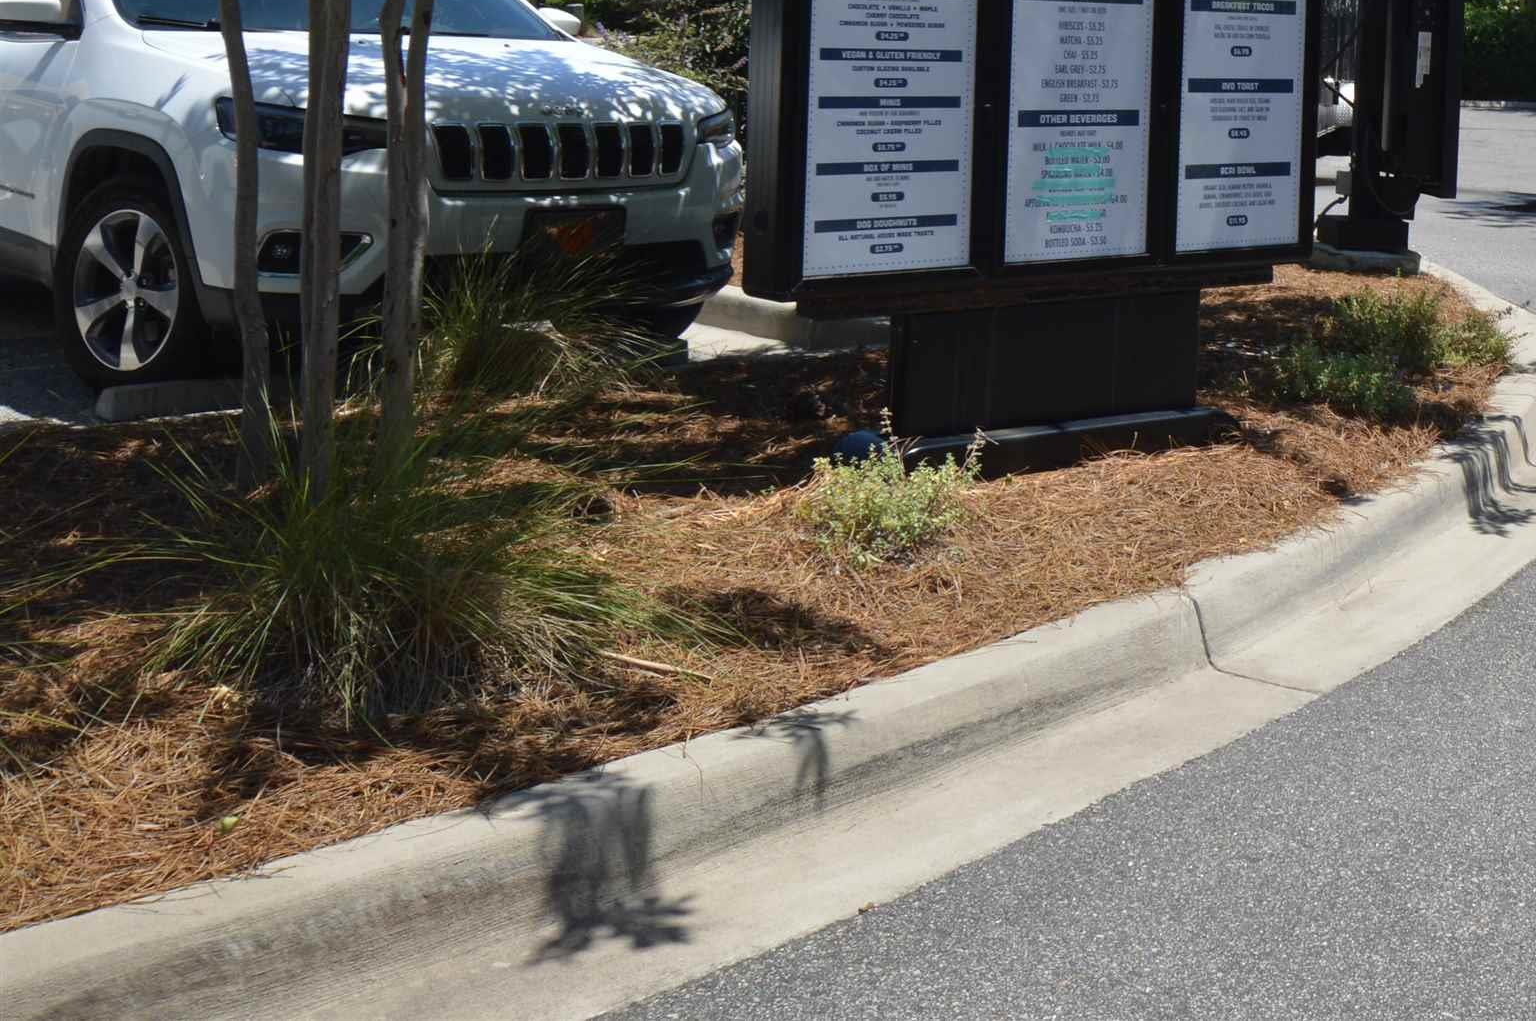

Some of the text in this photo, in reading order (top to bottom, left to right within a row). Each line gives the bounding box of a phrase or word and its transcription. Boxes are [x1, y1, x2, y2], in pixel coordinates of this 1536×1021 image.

[841, 50, 865, 58] VEGAN
[876, 51, 904, 59] GLUTEN
[1040, 114, 1118, 123] OTHER BEVERAGES
[882, 163, 891, 171] OF
